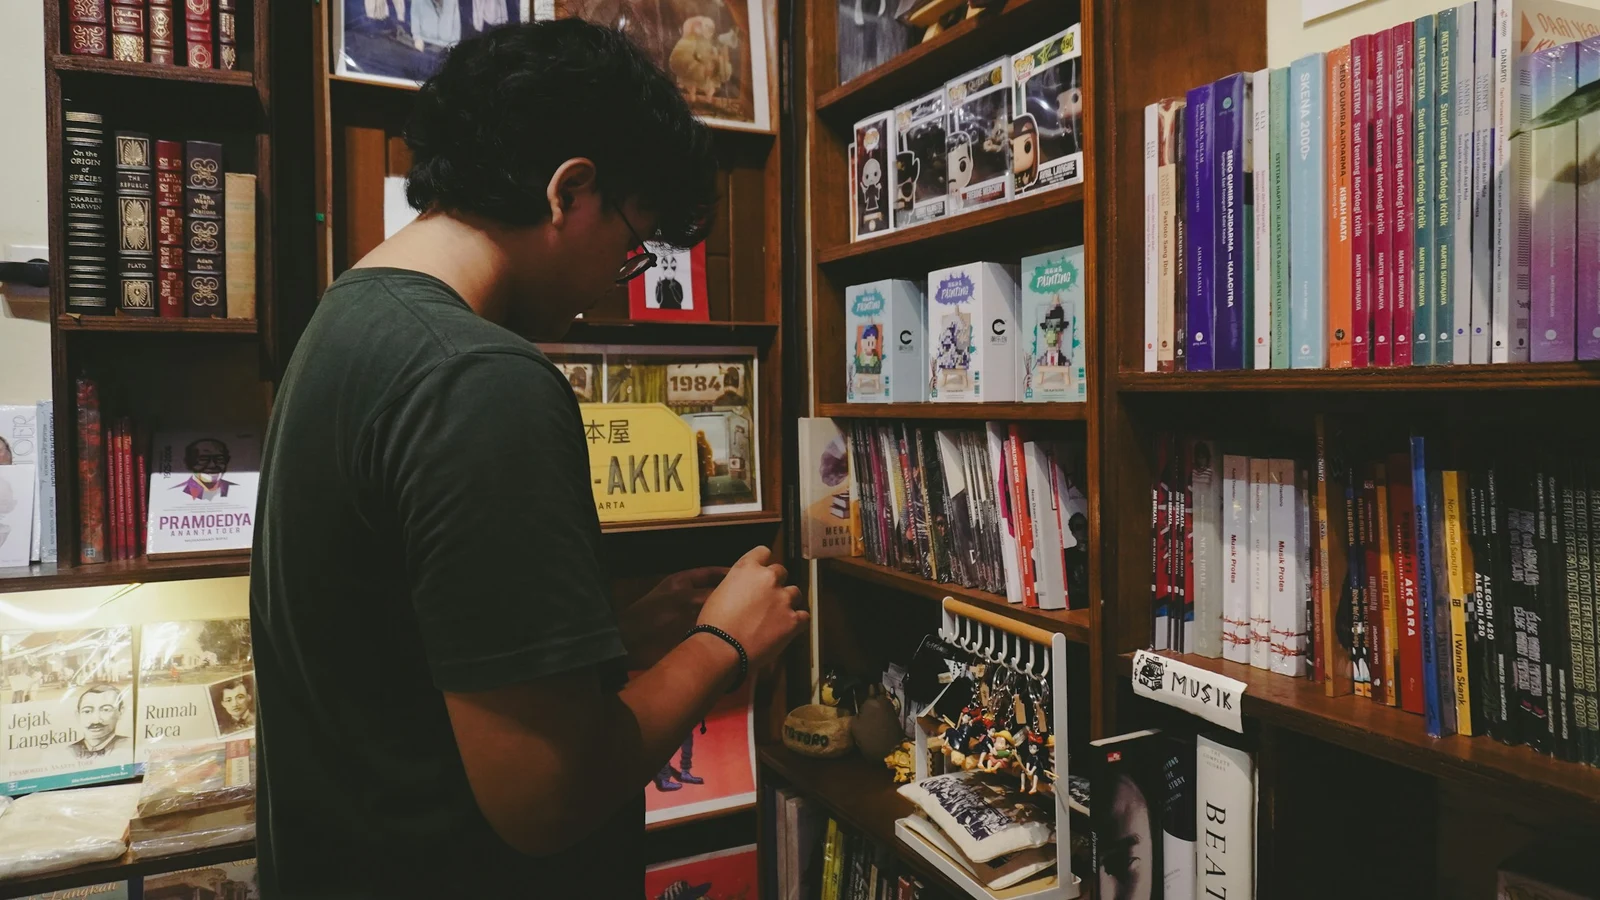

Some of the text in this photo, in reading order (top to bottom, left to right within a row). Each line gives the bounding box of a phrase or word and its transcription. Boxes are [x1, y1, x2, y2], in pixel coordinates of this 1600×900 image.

[1396, 44, 1404, 106] META-ESTETIKA
[1418, 37, 1426, 100] META-ESTETIKA
[1441, 31, 1449, 95] META-ESTETIKA
[1300, 73, 1311, 119] SKENA
[1396, 114, 1404, 136] Studi
[1418, 108, 1426, 131] Studi
[1440, 103, 1448, 126] Studi
[1353, 145, 1361, 175] tentang
[1375, 142, 1383, 172] tentang
[1395, 136, 1404, 168] tentang
[1417, 132, 1426, 164] tentang
[1439, 128, 1448, 160] tentang
[70, 174, 102, 182] SPECIES
[120, 181, 148, 189] REPUBLIC
[1376, 174, 1384, 211] Morfologi
[1396, 170, 1404, 208] Morfologi
[1417, 165, 1426, 205] Morfologi
[1439, 161, 1448, 201] Morfologi
[1397, 210, 1405, 232] Kritik
[1418, 206, 1426, 229] Kritik
[1439, 203, 1448, 226] Kritik
[941, 286, 969, 299] PAINTING
[1036, 271, 1071, 288] PAINTING
[669, 376, 722, 392] 1984
[584, 419, 631, 444] 本屋
[159, 513, 251, 530] PRAMOEDYA
[1447, 499, 1459, 576] Nor Rahman Saputra
[1565, 531, 1577, 570] SKETSA
[1578, 532, 1590, 571] SKETSA
[1416, 505, 1432, 664] GOING SOUTH NORTH
[1566, 570, 1579, 592] DAN
[1580, 572, 1591, 594] DAN
[1405, 578, 1415, 637] AKSARA
[1475, 572, 1486, 637] ALEGORI 420
[1484, 574, 1495, 640] ALEGORI 420
[1568, 592, 1582, 640] REFLEKSI
[1581, 595, 1594, 644] REFLEKSI
[1455, 640, 1467, 705] Wanna Skank
[1570, 642, 1584, 690] HISTORIS
[1583, 644, 1597, 692] HISTORIS
[1171, 672, 1232, 710] MUSIK
[8, 710, 51, 732] Jejak
[145, 703, 197, 720] Rumah
[1573, 693, 1587, 728] (2007)
[8, 728, 78, 750] Langkah
[143, 723, 181, 740] Kaca
[1168, 776, 1186, 790] STORY
